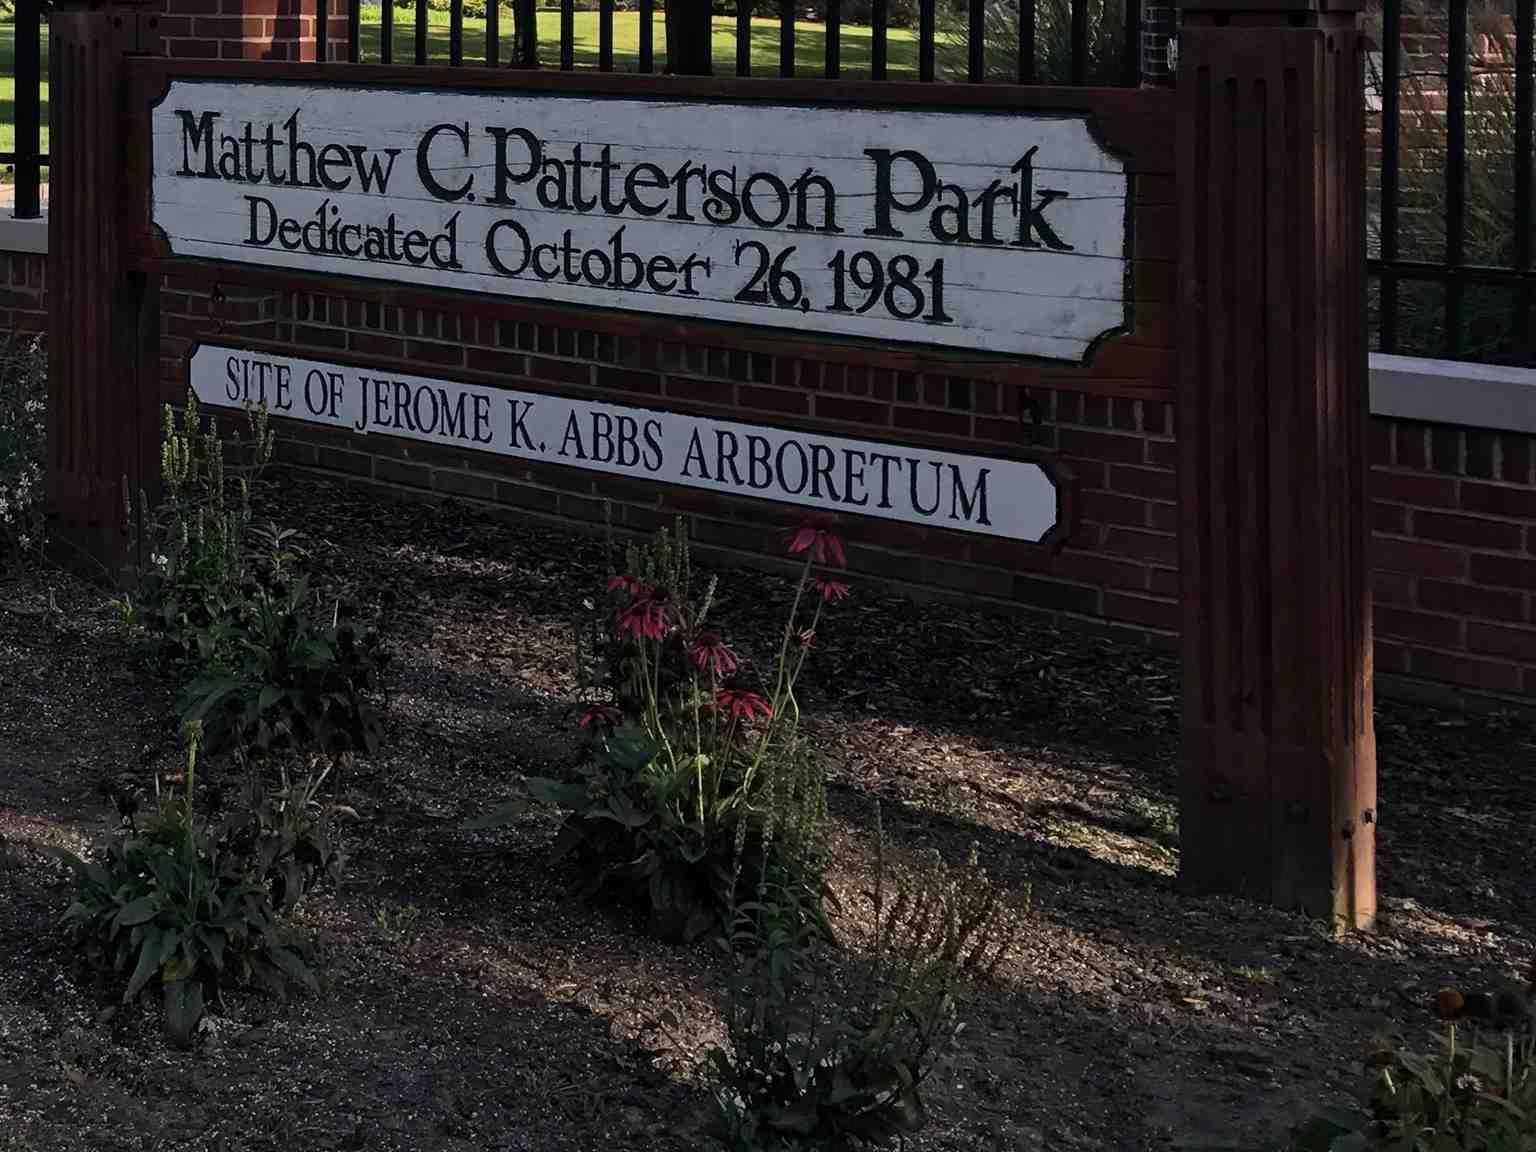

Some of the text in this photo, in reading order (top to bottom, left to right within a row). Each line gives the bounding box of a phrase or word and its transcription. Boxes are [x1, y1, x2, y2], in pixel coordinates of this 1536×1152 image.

[174, 107, 1075, 250] Matthew C. Patterson Park
[243, 194, 954, 323] Dedicated October 26, 1981
[225, 355, 993, 527] SITE OF JEROME K. ABBS ARBORETUM
